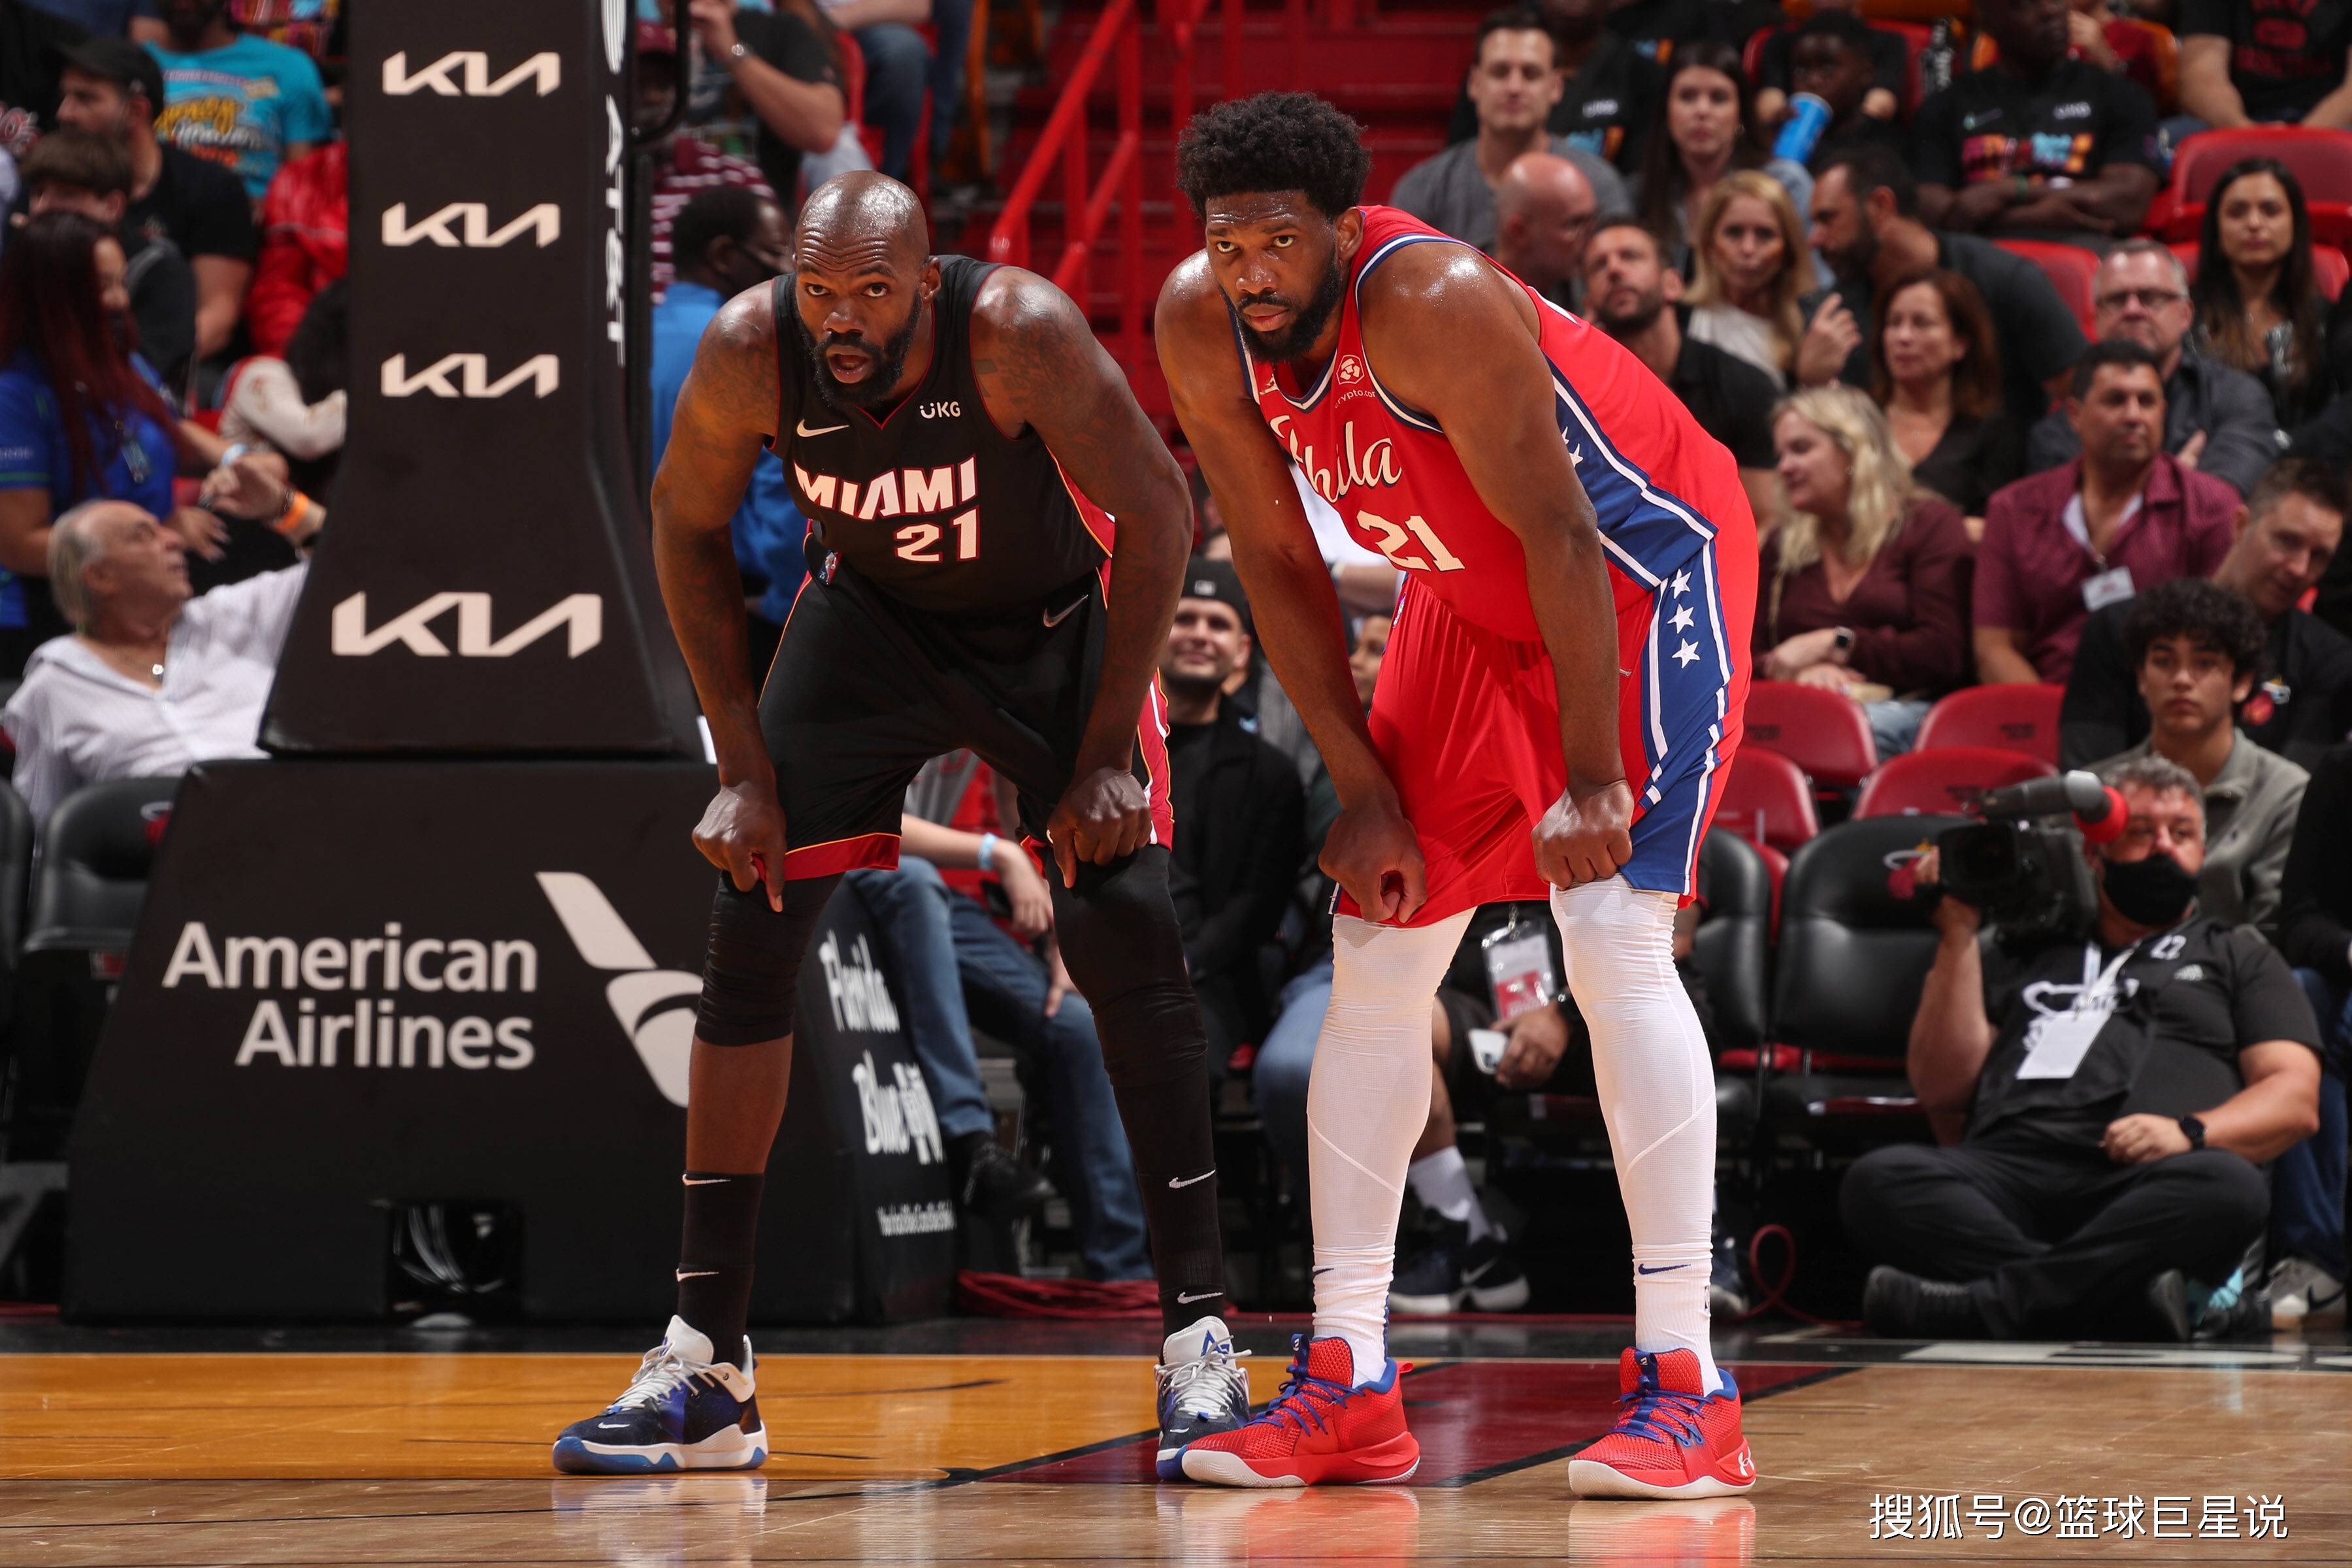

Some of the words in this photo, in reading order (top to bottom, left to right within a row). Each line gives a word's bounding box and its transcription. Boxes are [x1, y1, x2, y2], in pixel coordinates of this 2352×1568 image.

[793, 455, 977, 521] MIAMI
[894, 506, 979, 562] 21
[1356, 510, 1465, 572] 21
[162, 922, 536, 992] American
[237, 998, 534, 1069] Airlines
